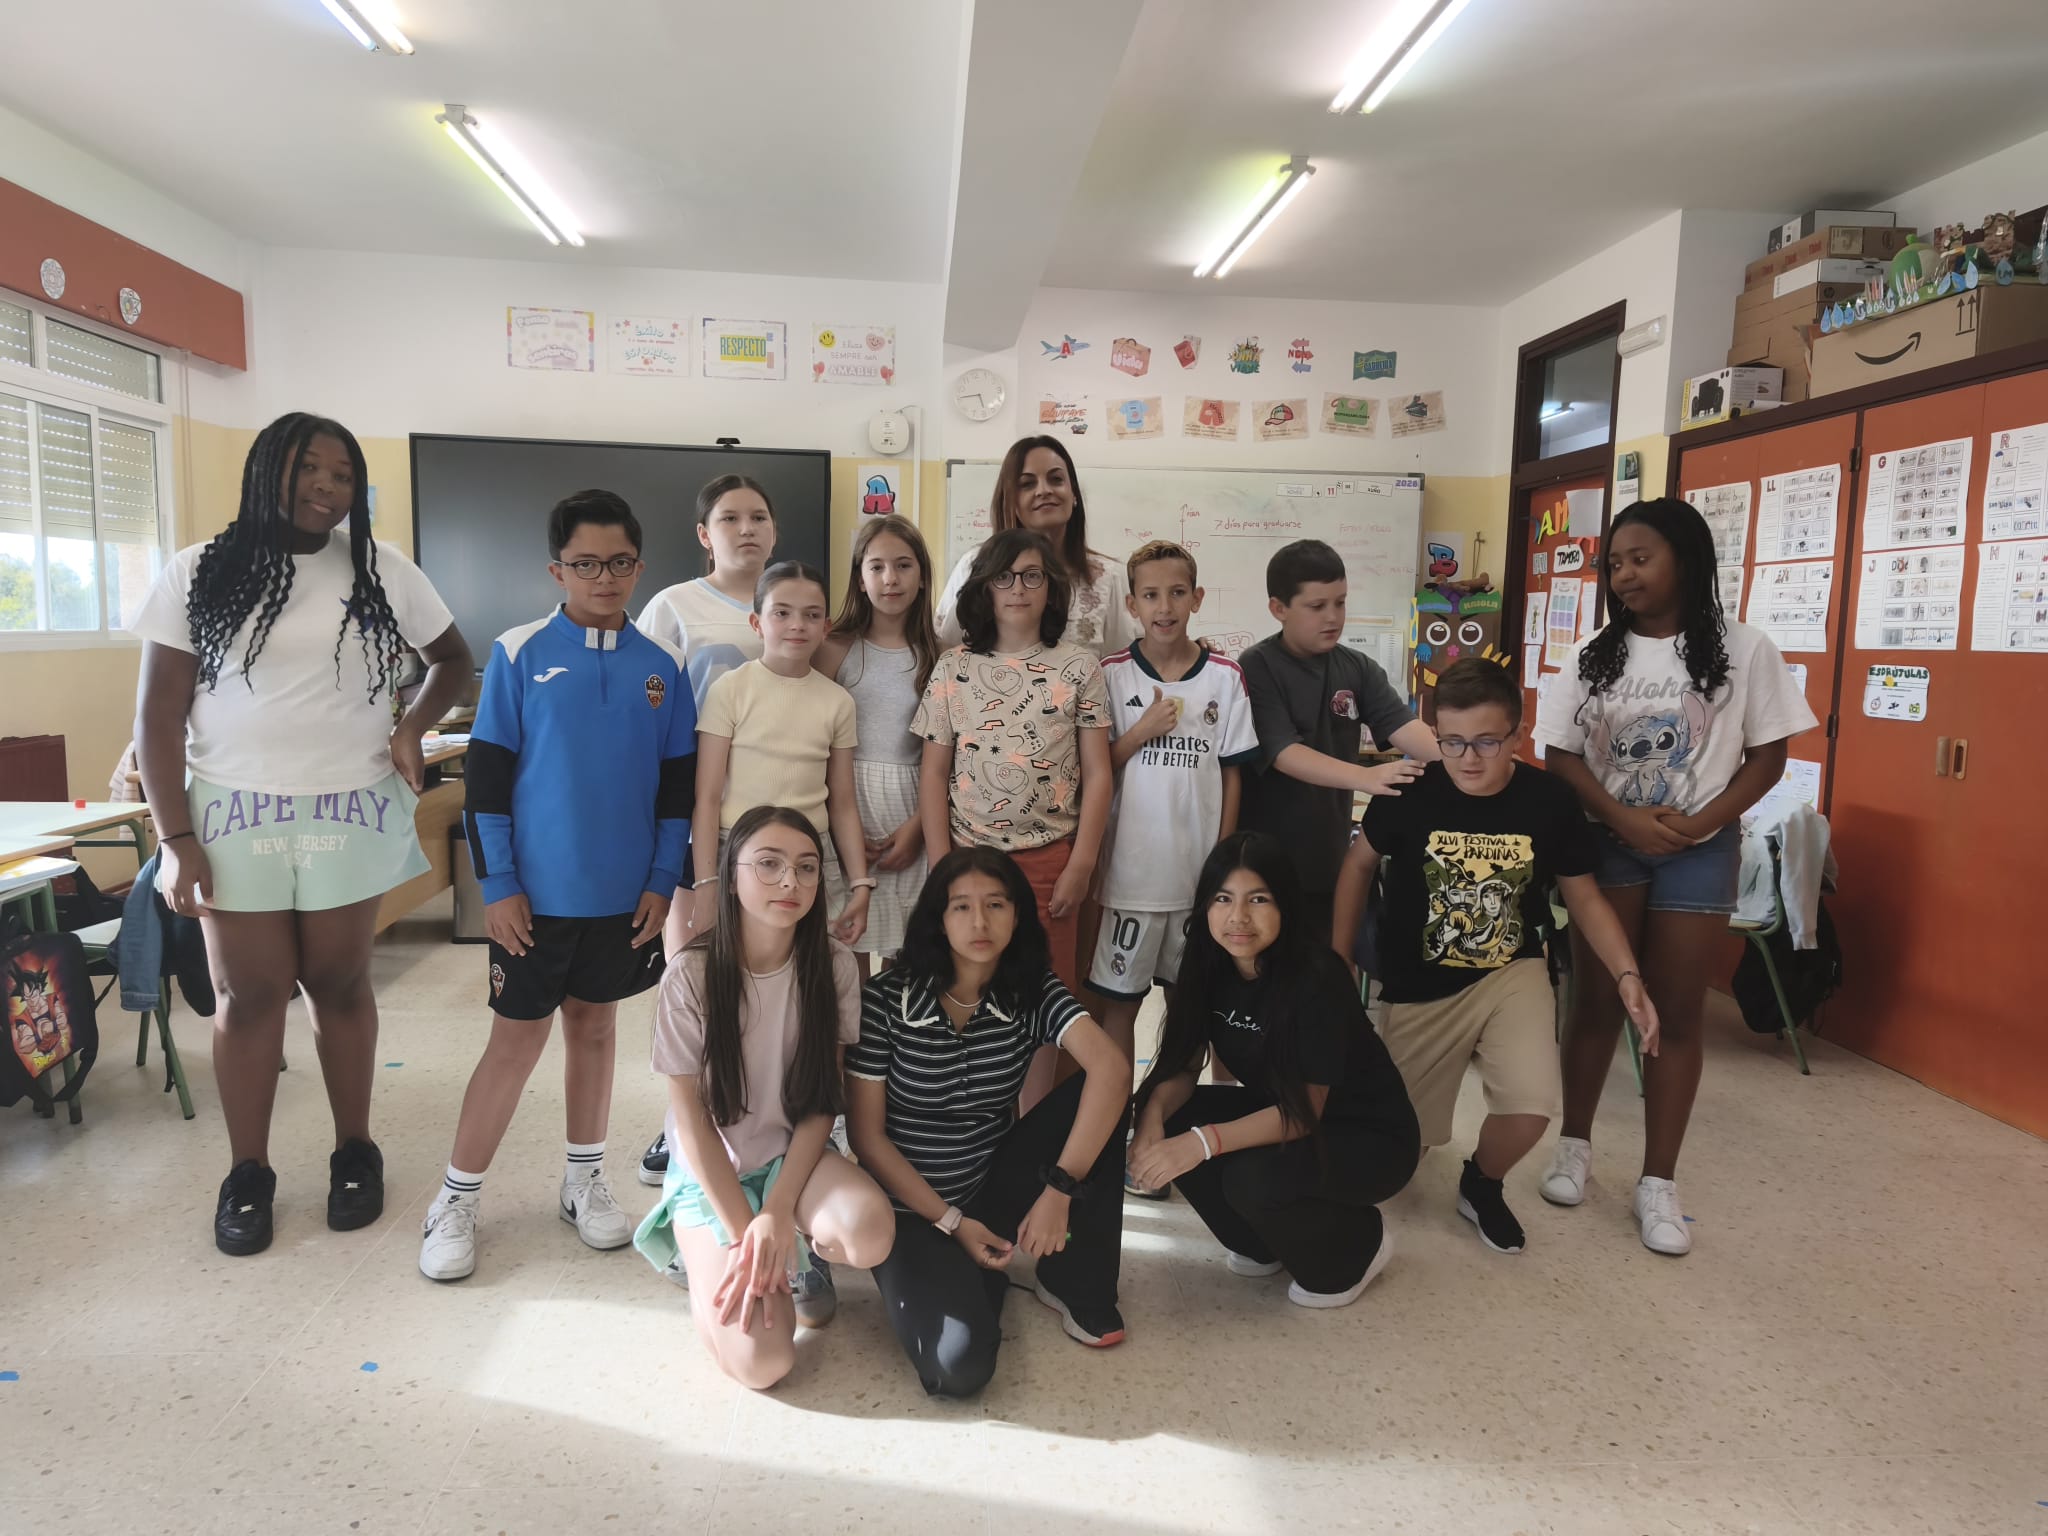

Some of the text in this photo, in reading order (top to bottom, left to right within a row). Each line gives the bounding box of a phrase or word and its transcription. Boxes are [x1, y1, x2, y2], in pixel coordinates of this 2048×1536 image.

[720, 335, 767, 358] RESPECTO
[1878, 455, 1887, 469] G
[1766, 479, 1777, 493] LL
[1214, 519, 1224, 530] 7
[1242, 521, 1260, 532] para
[1262, 518, 1302, 530] graduarse
[1868, 559, 1877, 573] J
[1142, 750, 1200, 769] FLY BETTER
[202, 790, 390, 845] CAPE MAY
[252, 834, 348, 855] NEW JERSEY
[1437, 834, 1458, 846] XLVI
[1459, 835, 1510, 846] FESTIVAL
[283, 853, 313, 869] USA
[1463, 845, 1520, 861] PARDIÑAS
[1112, 910, 1141, 951] 10
